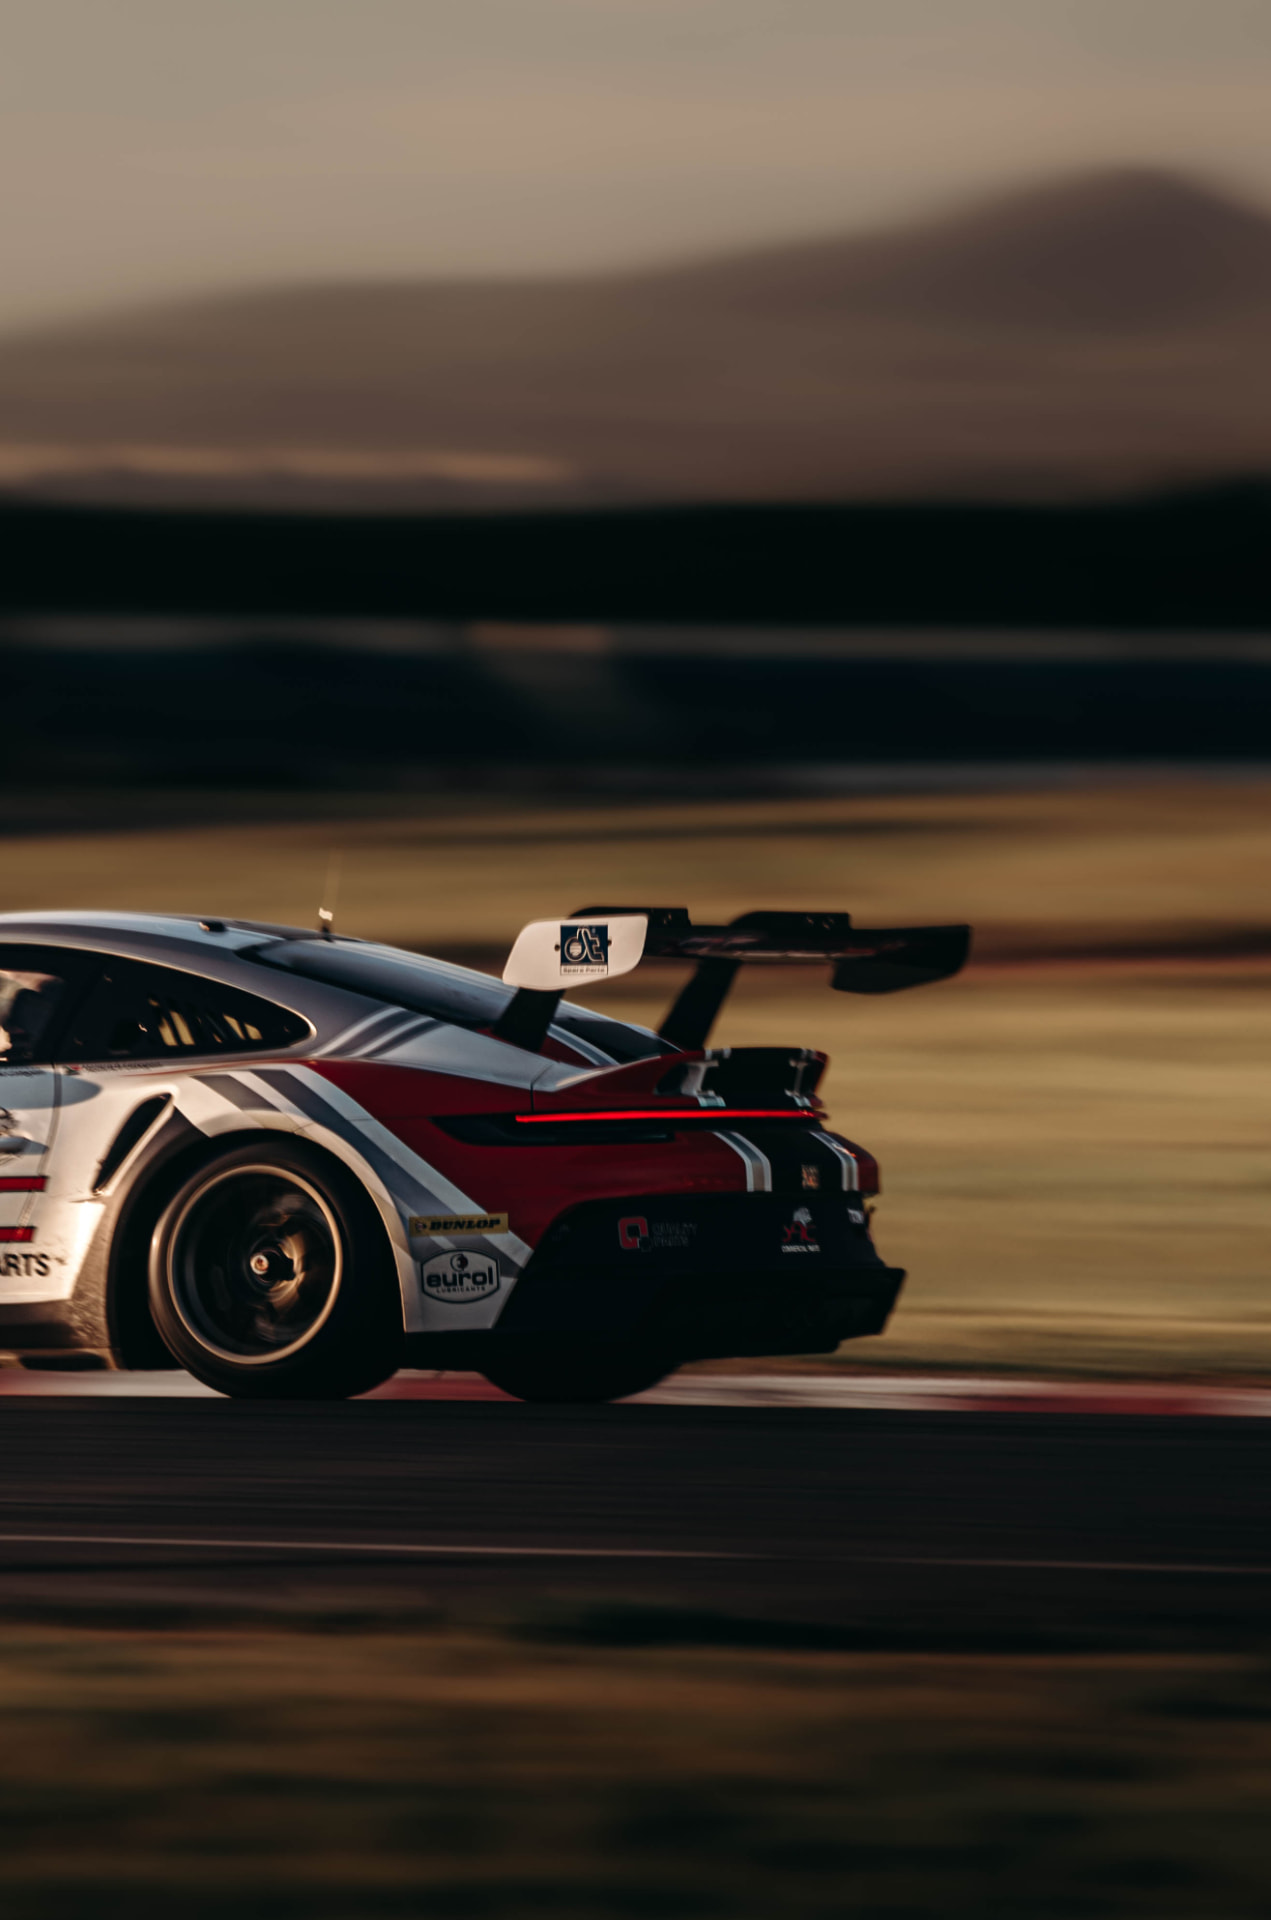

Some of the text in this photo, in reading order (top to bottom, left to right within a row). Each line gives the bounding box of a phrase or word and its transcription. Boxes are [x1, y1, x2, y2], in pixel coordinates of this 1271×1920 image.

[430, 1219, 500, 1230] DUNLOP
[427, 1267, 493, 1287] eurol
[436, 1286, 485, 1294] LUBRICANTS
